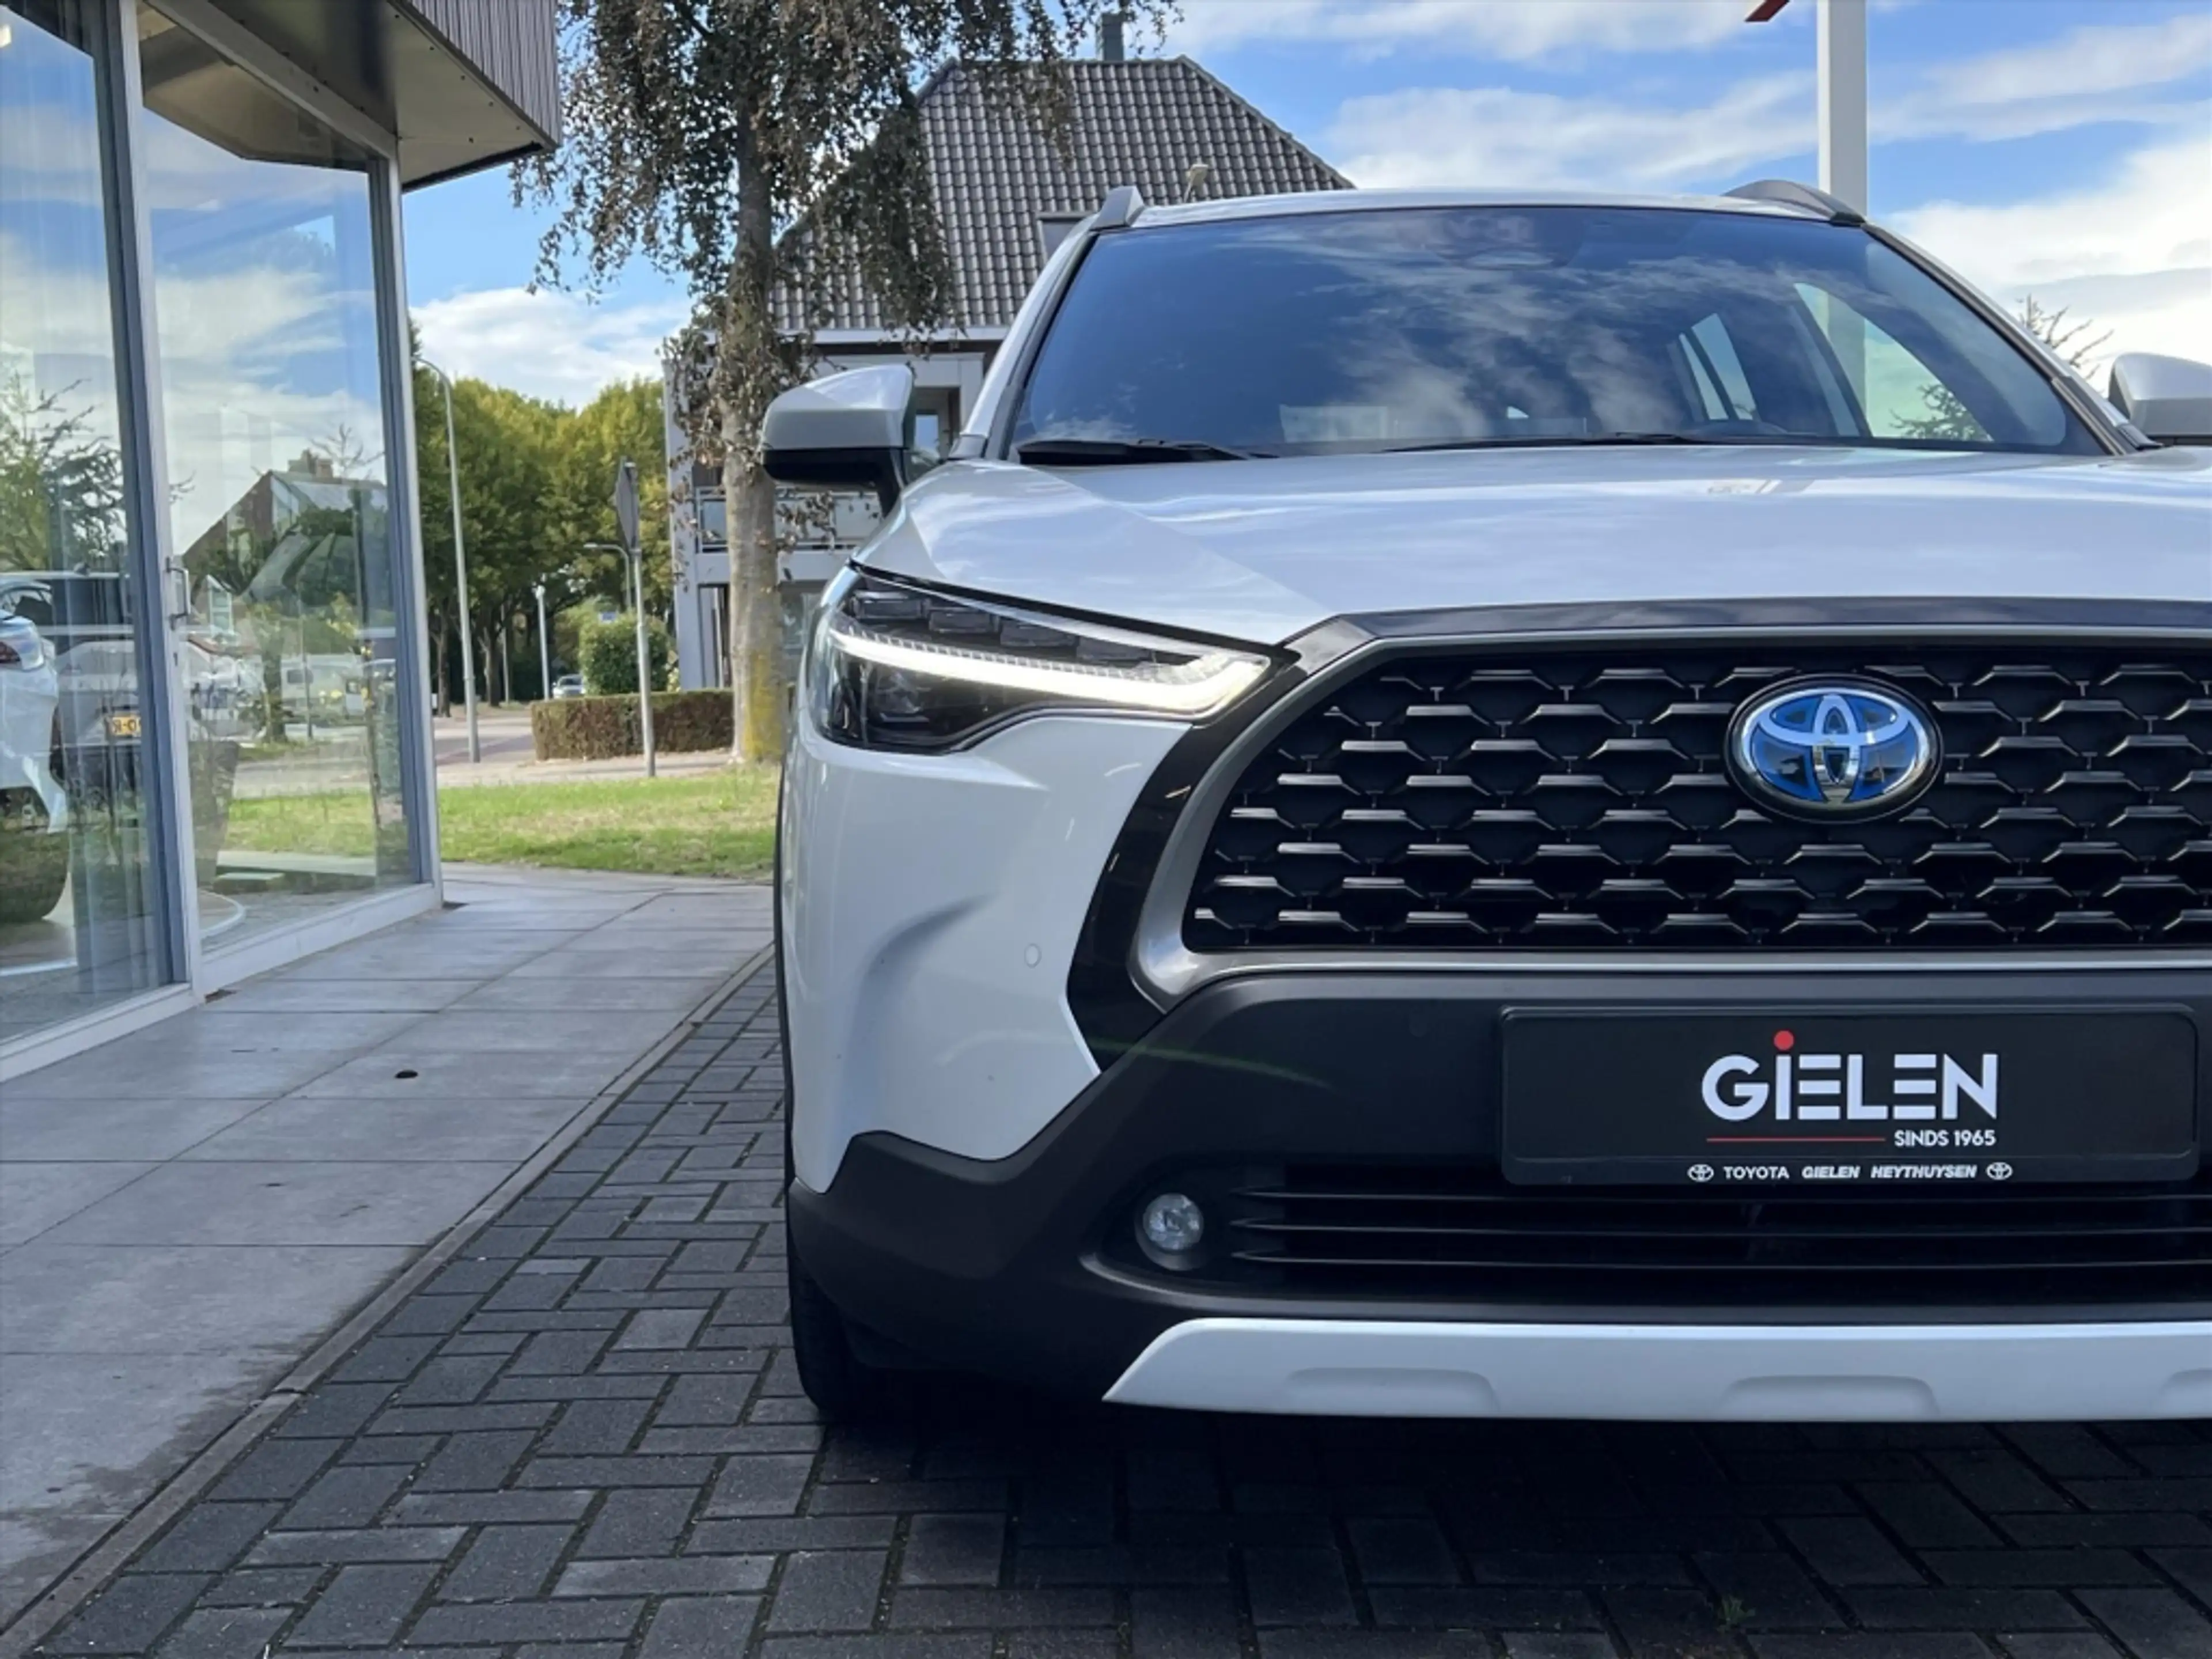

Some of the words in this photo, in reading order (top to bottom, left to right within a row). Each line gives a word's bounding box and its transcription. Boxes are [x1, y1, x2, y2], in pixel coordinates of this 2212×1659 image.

[1893, 1130, 1949, 1147] SINDS
[1953, 1130, 1997, 1147] 1965
[1723, 1165, 1790, 1180] TOYOTA
[1801, 1165, 1861, 1180] GIELEN
[1870, 1164, 1978, 1180] HEYTHUYSEN
